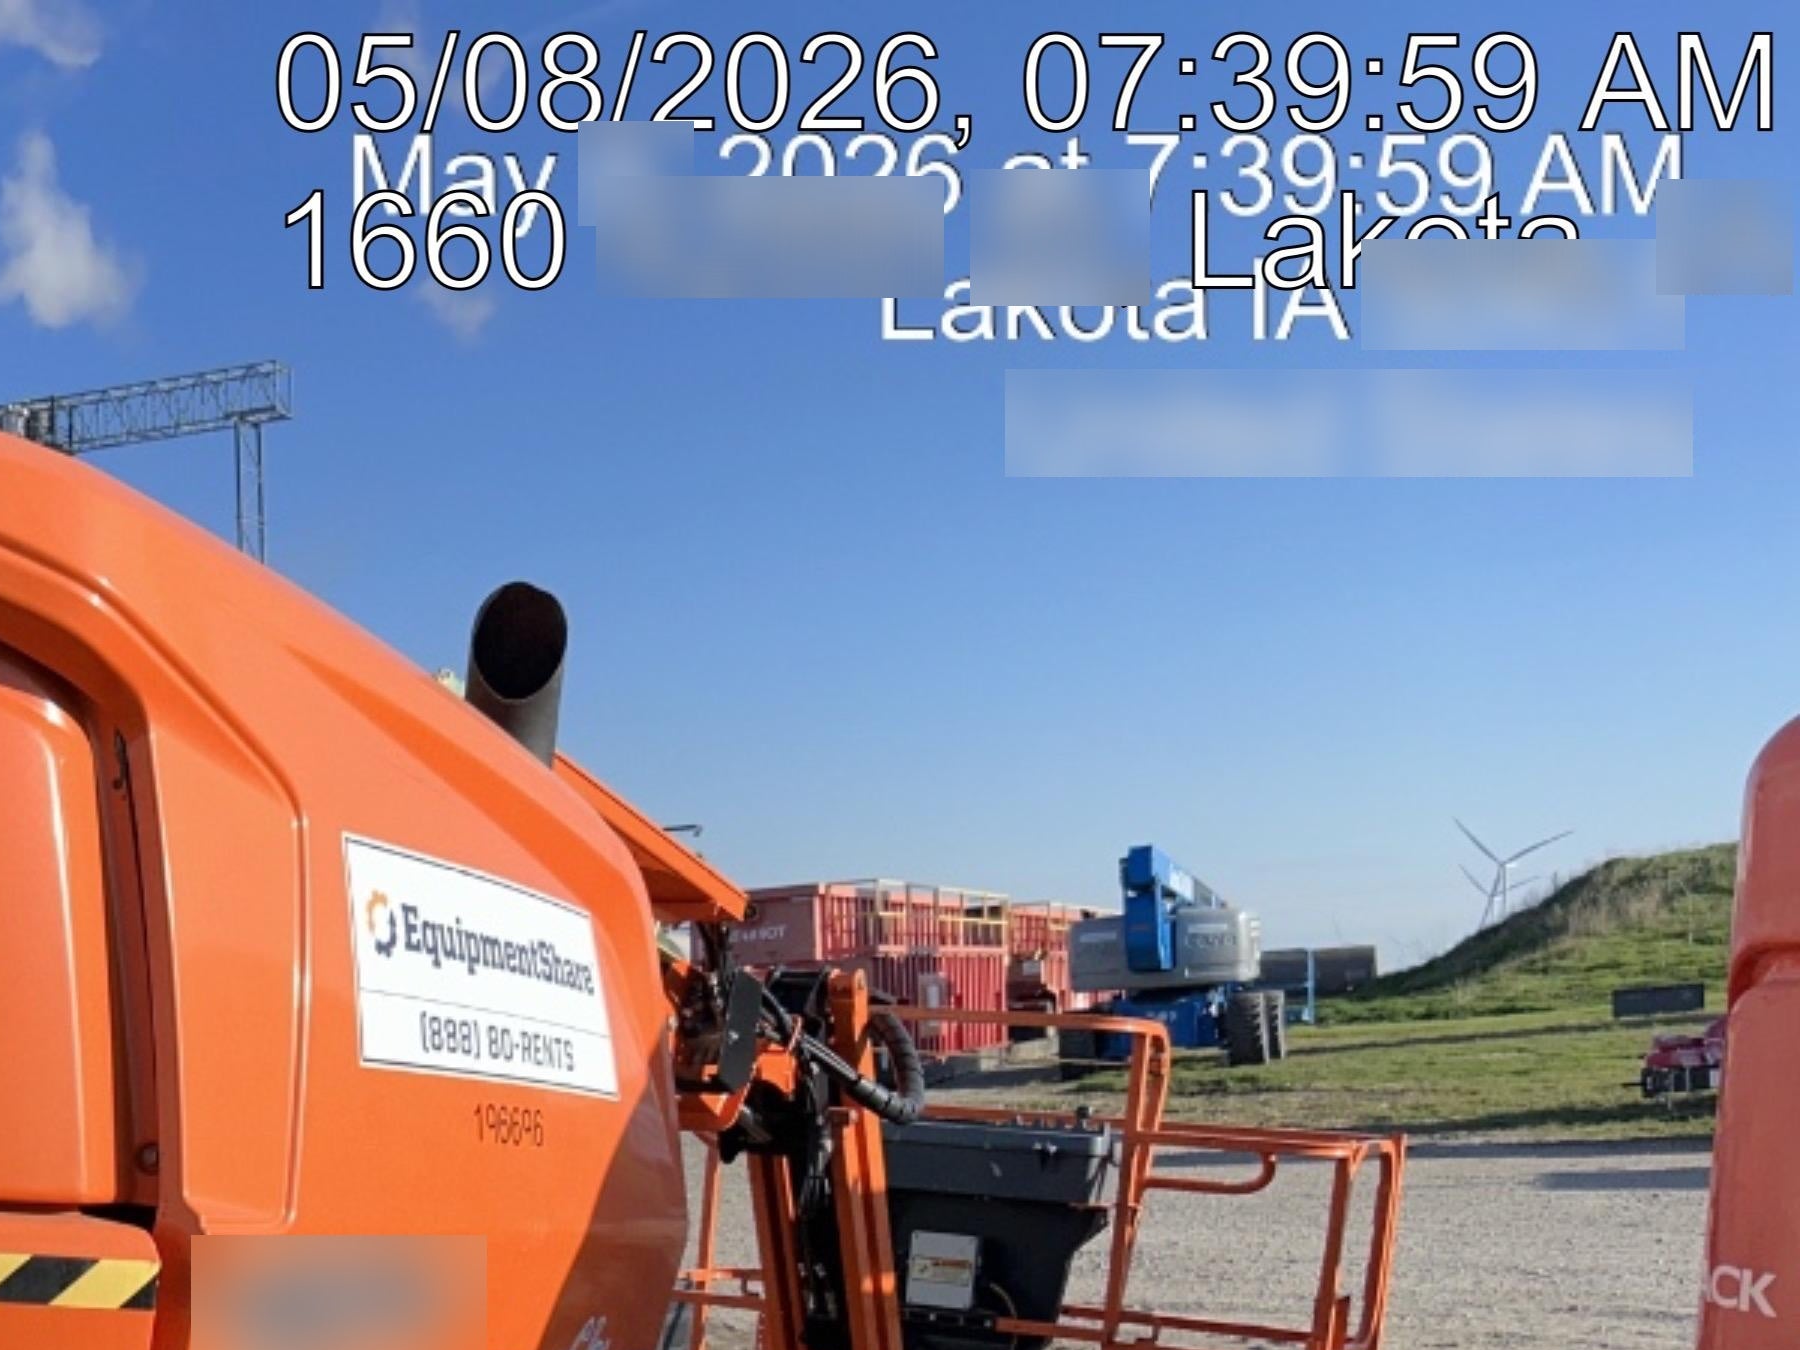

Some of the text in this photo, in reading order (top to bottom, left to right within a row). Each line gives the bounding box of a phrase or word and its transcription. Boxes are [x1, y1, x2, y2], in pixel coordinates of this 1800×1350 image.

[400, 902, 595, 997] EquipmentShare
[420, 1010, 481, 1061] (888)
[473, 1102, 545, 1148] 196696
[1706, 1264, 1777, 1319] CK
